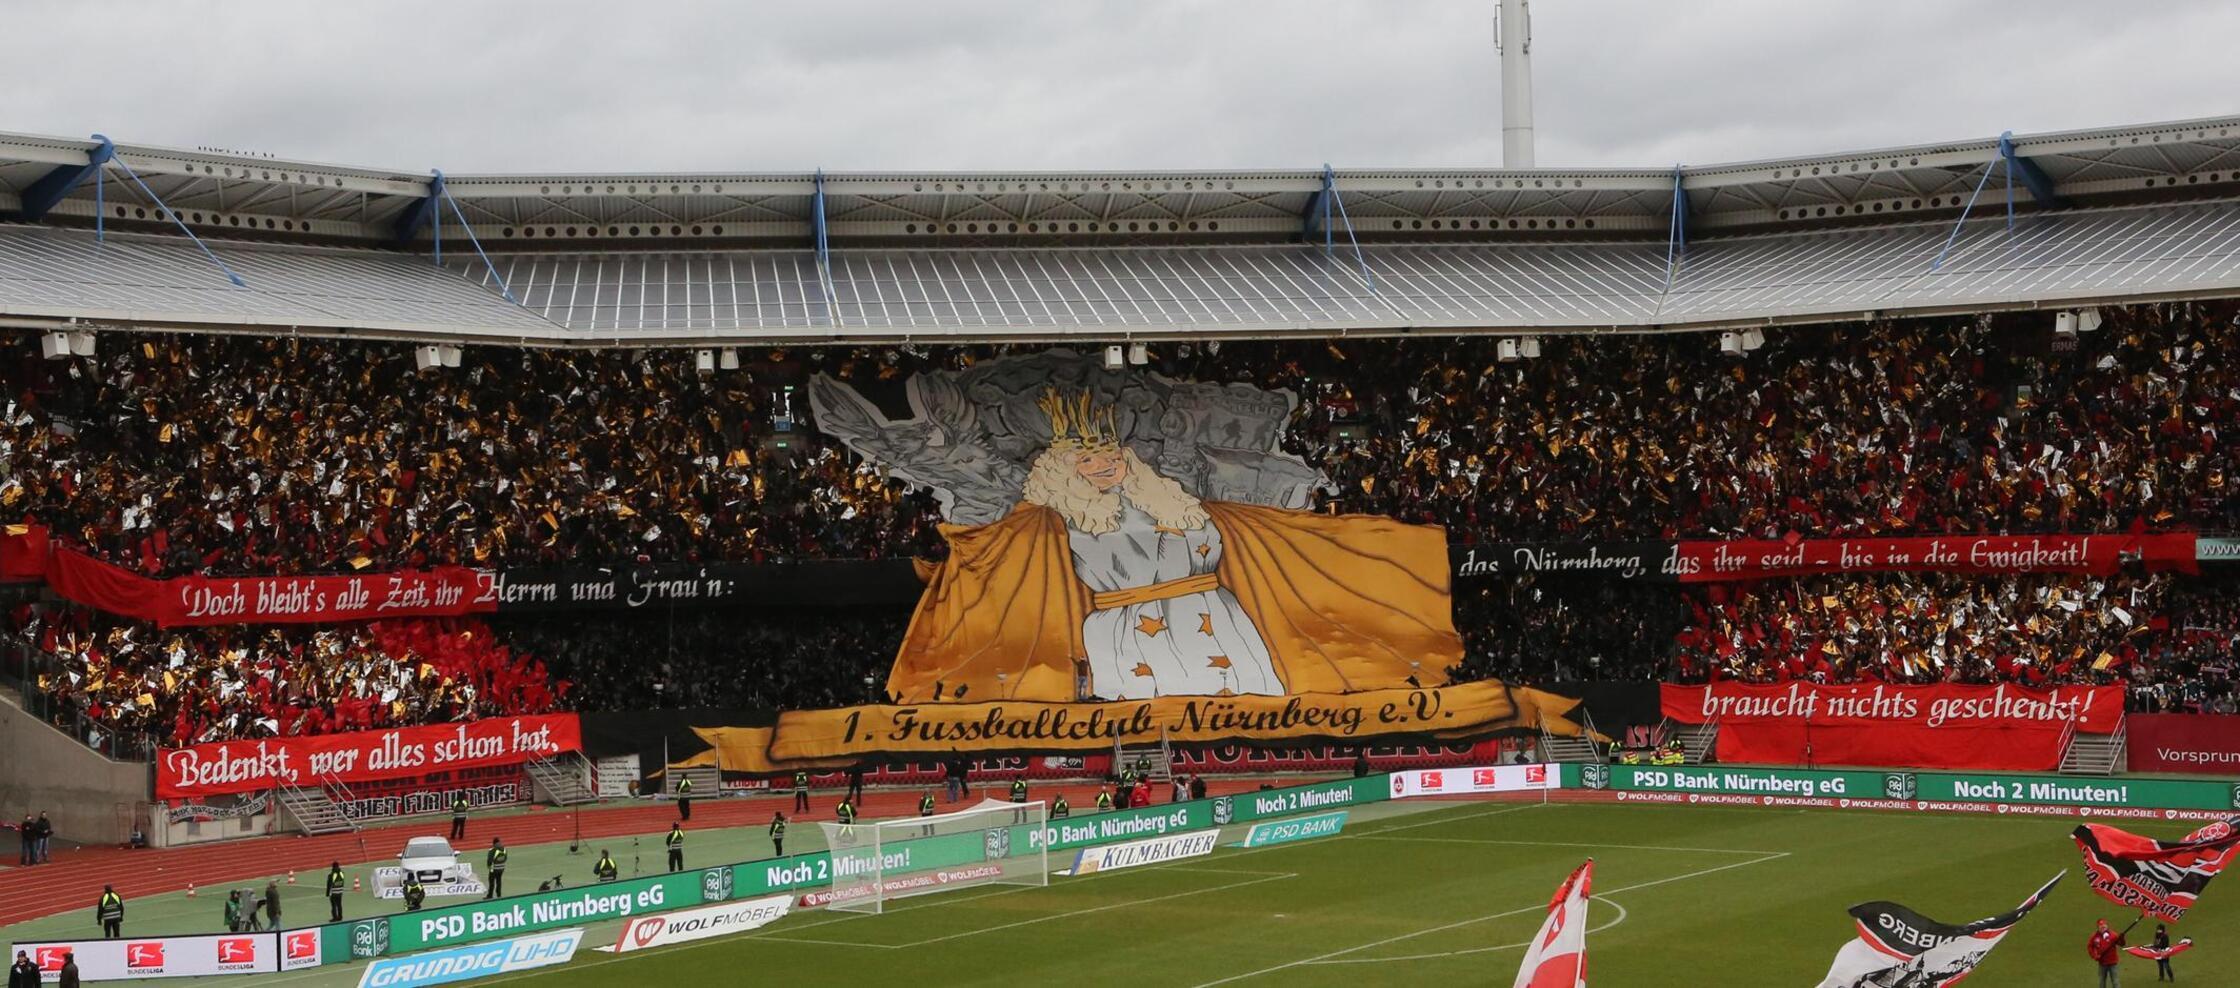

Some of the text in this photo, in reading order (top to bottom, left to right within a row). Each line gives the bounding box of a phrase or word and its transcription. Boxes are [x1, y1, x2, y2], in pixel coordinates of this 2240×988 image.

[1459, 549, 1498, 576] das
[1661, 544, 1701, 575] das
[1712, 545, 1747, 572] ihr
[1761, 542, 1804, 569] seid
[1887, 545, 1909, 566] in
[1924, 541, 1959, 566] die
[1970, 537, 2090, 573] Ewigkeit!
[182, 581, 245, 617] Doch
[335, 577, 370, 611] alle
[377, 577, 430, 611] Zeit,
[435, 577, 462, 606] ihr
[473, 569, 557, 604] Herrn
[571, 568, 616, 601] und
[843, 690, 1453, 744] 1. Fussballclub Nürnberg e.V.
[1702, 683, 2094, 727] braucht nichts geschenkt!
[167, 740, 298, 788] Bedenkt,
[309, 747, 359, 776] wer
[368, 732, 425, 770] alles
[433, 724, 505, 763] schon
[511, 719, 559, 753] hat,
[1634, 771, 1845, 796] PSD Bank Nürnberg eG
[1954, 781, 2127, 802] Noch 2 Minuten!
[1256, 795, 1286, 815] Noch
[1290, 793, 1297, 809] 2
[1300, 785, 1353, 807] Minuten!
[1700, 795, 1758, 804] WOLFMÖBEL
[1775, 797, 1834, 807] WOLFMÖBEL
[1852, 800, 1912, 810] WOLFMÖBEL
[1929, 802, 1991, 812] WOLFMÖBEL
[2010, 805, 2074, 815] WOLFMÖBEL
[2093, 808, 2160, 818] WOLFMÖBEL
[1029, 828, 1058, 849] PSD
[1062, 822, 1097, 843] Bank
[1101, 815, 1166, 837] Nürnberg
[1169, 809, 1187, 826] eG
[1272, 825, 1299, 840] PSD
[1301, 817, 1340, 835] BANK
[1101, 834, 1215, 869] KULMBACHER
[767, 848, 911, 887] Noch 2 Minuten!
[421, 884, 664, 942] PSD Bank Nürnberg eG
[668, 905, 781, 935] WOLFMÖBEL
[370, 936, 576, 988] GRUNDIG UHD
